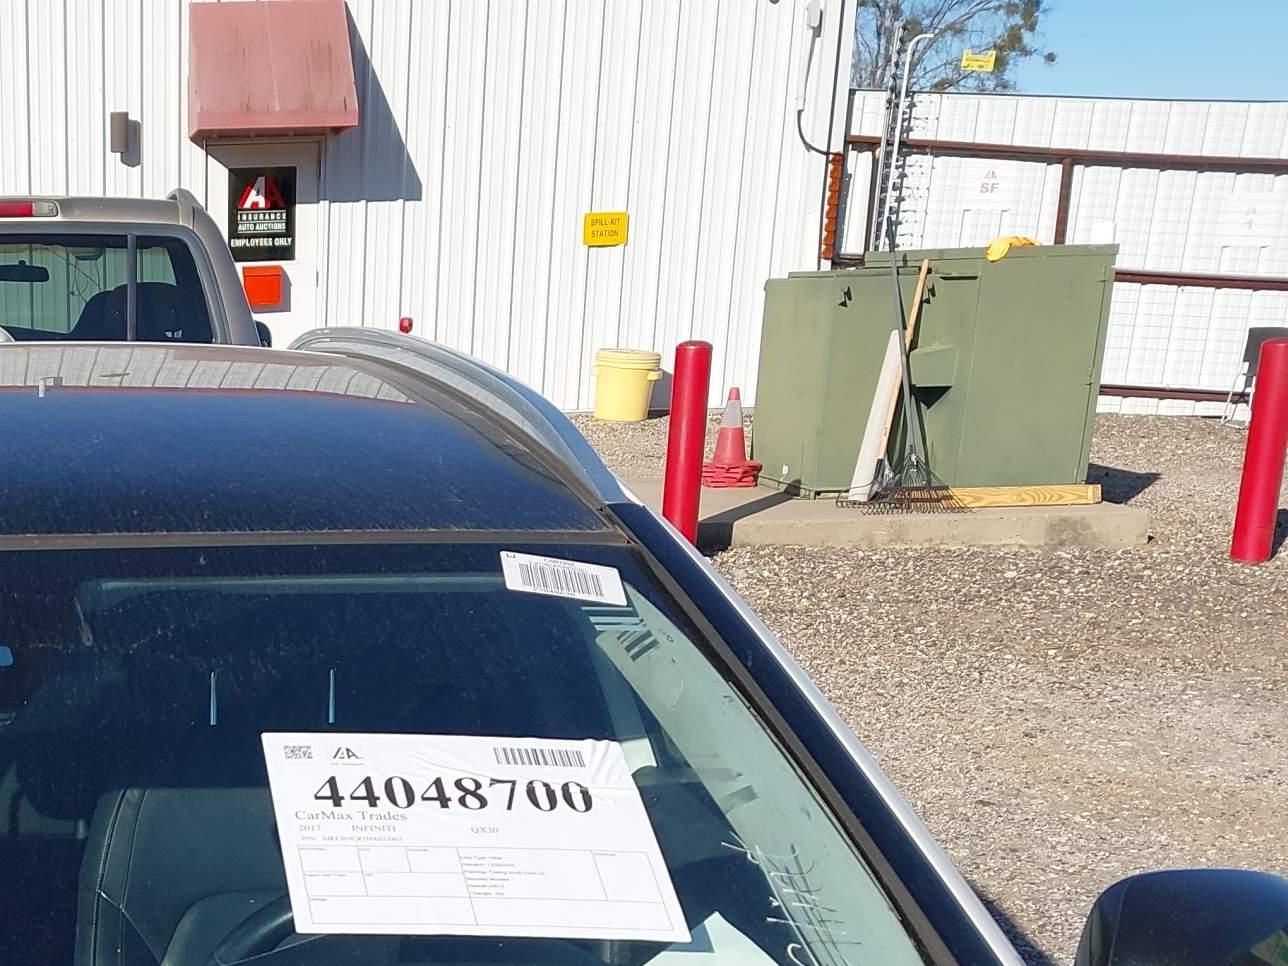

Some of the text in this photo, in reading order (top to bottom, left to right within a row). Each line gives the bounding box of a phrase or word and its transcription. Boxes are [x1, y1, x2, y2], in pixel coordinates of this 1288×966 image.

[980, 182, 1000, 193] SF
[238, 213, 286, 221] INSURANCE
[591, 217, 620, 226] SPILL KIT
[238, 222, 286, 231] AUTO AUCTIONS
[592, 229, 619, 238] STATION
[231, 237, 292, 247] EMPLOYEES ONLY
[314, 775, 593, 813] 44048700
[295, 810, 408, 821] CarMax Trades
[298, 824, 321, 832] 2017
